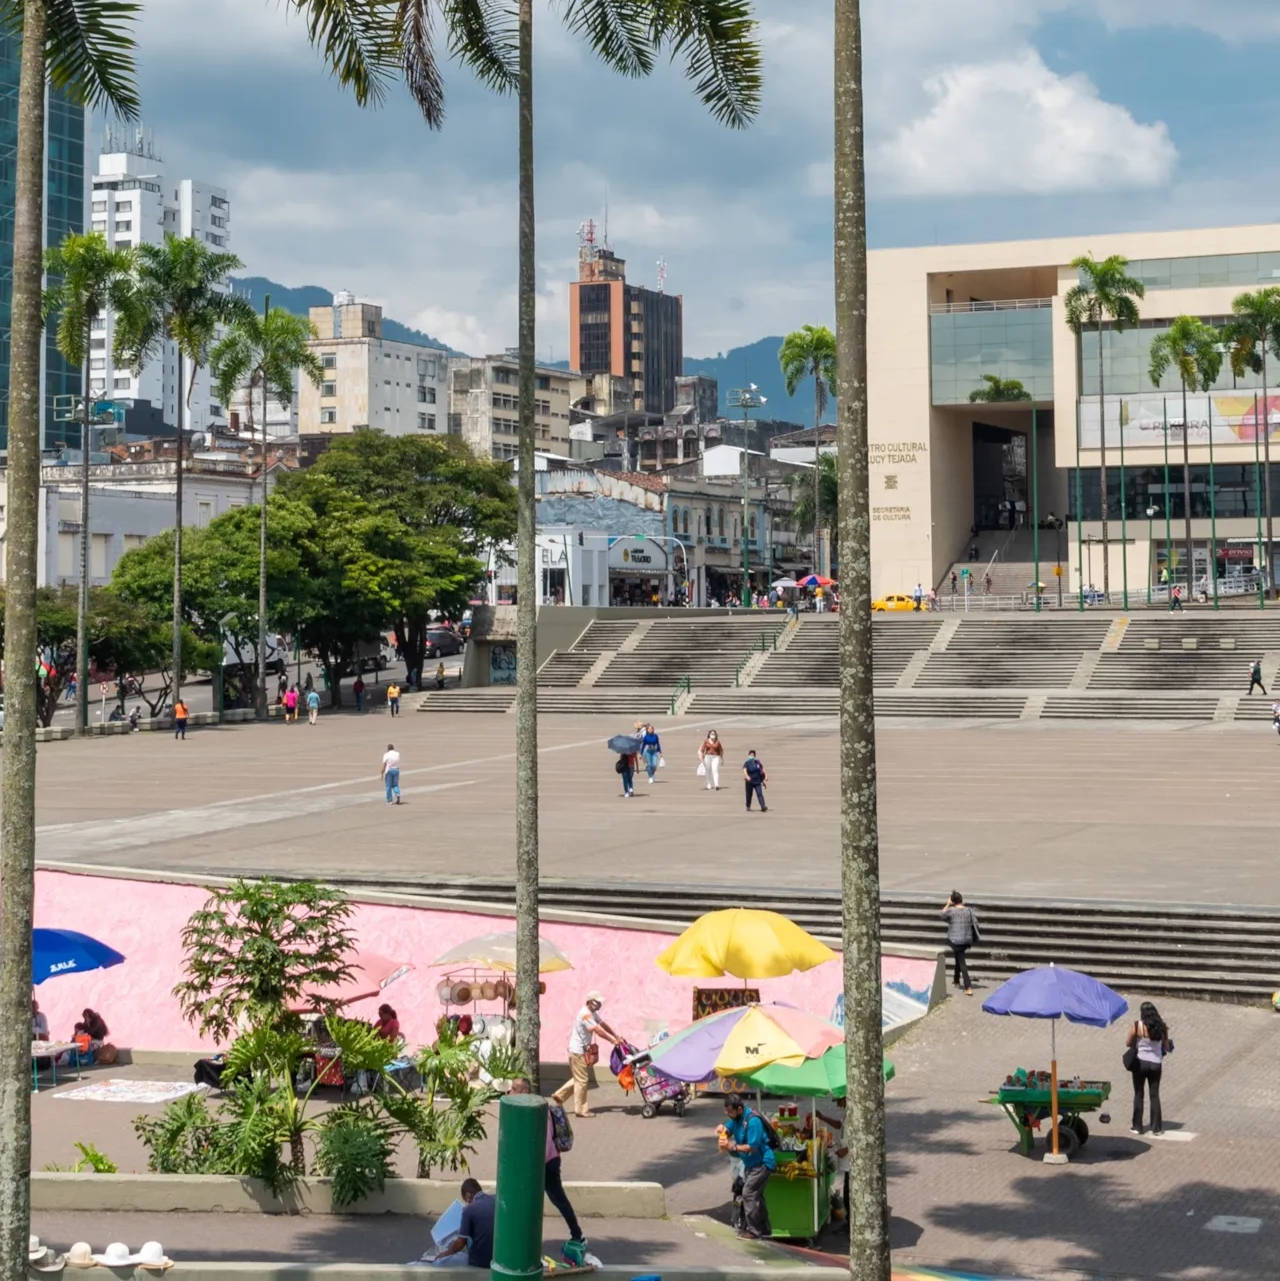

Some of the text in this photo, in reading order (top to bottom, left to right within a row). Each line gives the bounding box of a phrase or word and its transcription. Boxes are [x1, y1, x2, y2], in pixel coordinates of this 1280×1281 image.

[887, 442, 928, 452] CULTURAL
[888, 453, 917, 464] TEJADA
[542, 548, 567, 563] ELA
